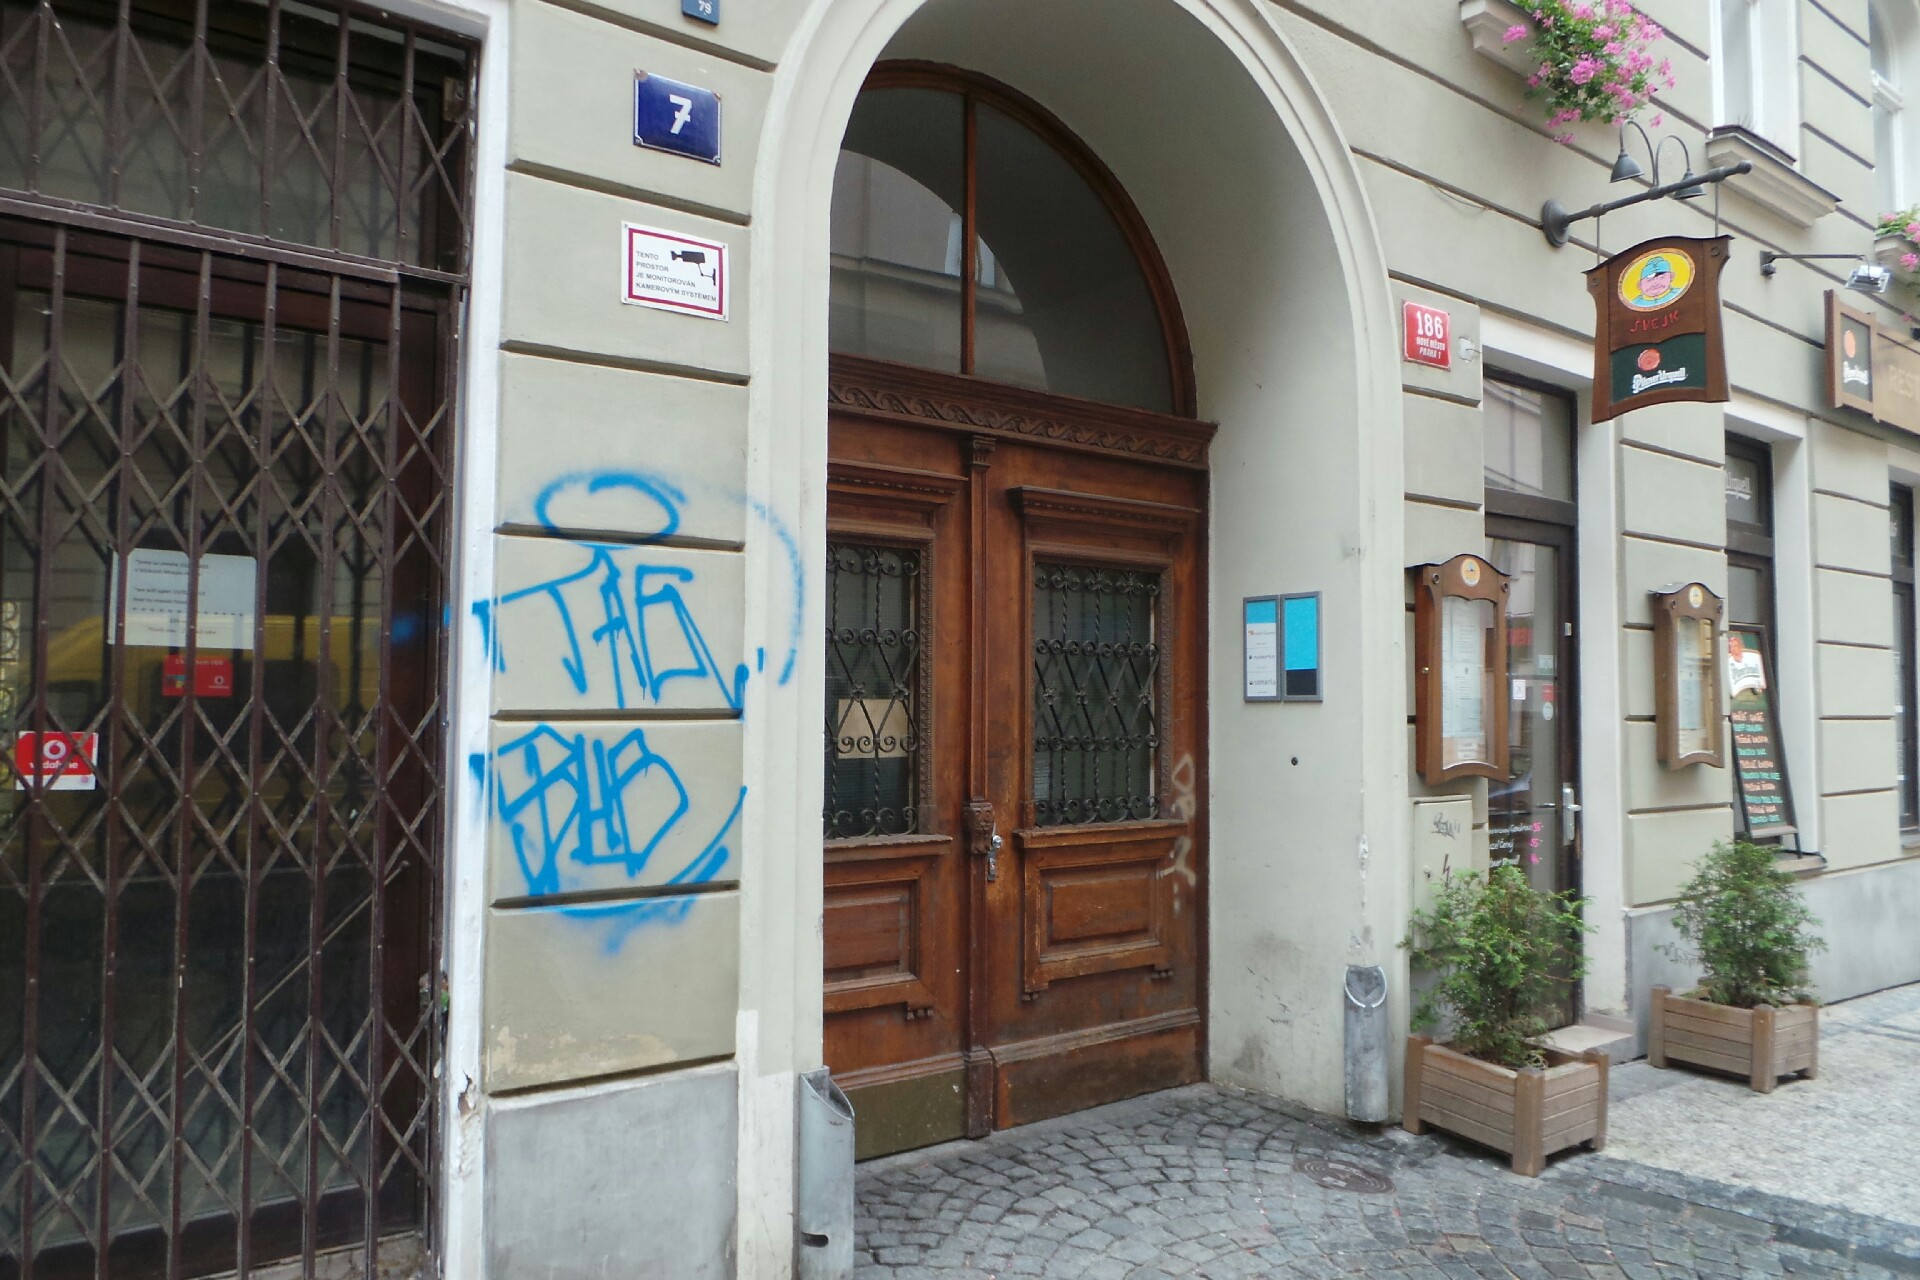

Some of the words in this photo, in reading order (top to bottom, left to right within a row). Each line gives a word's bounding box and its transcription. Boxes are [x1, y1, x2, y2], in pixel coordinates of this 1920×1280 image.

[669, 93, 693, 135] 7
[636, 250, 659, 261] TENTO
[636, 261, 669, 272] PROSTOR
[1416, 310, 1444, 339] 186
[1419, 346, 1437, 359] PRAHA
